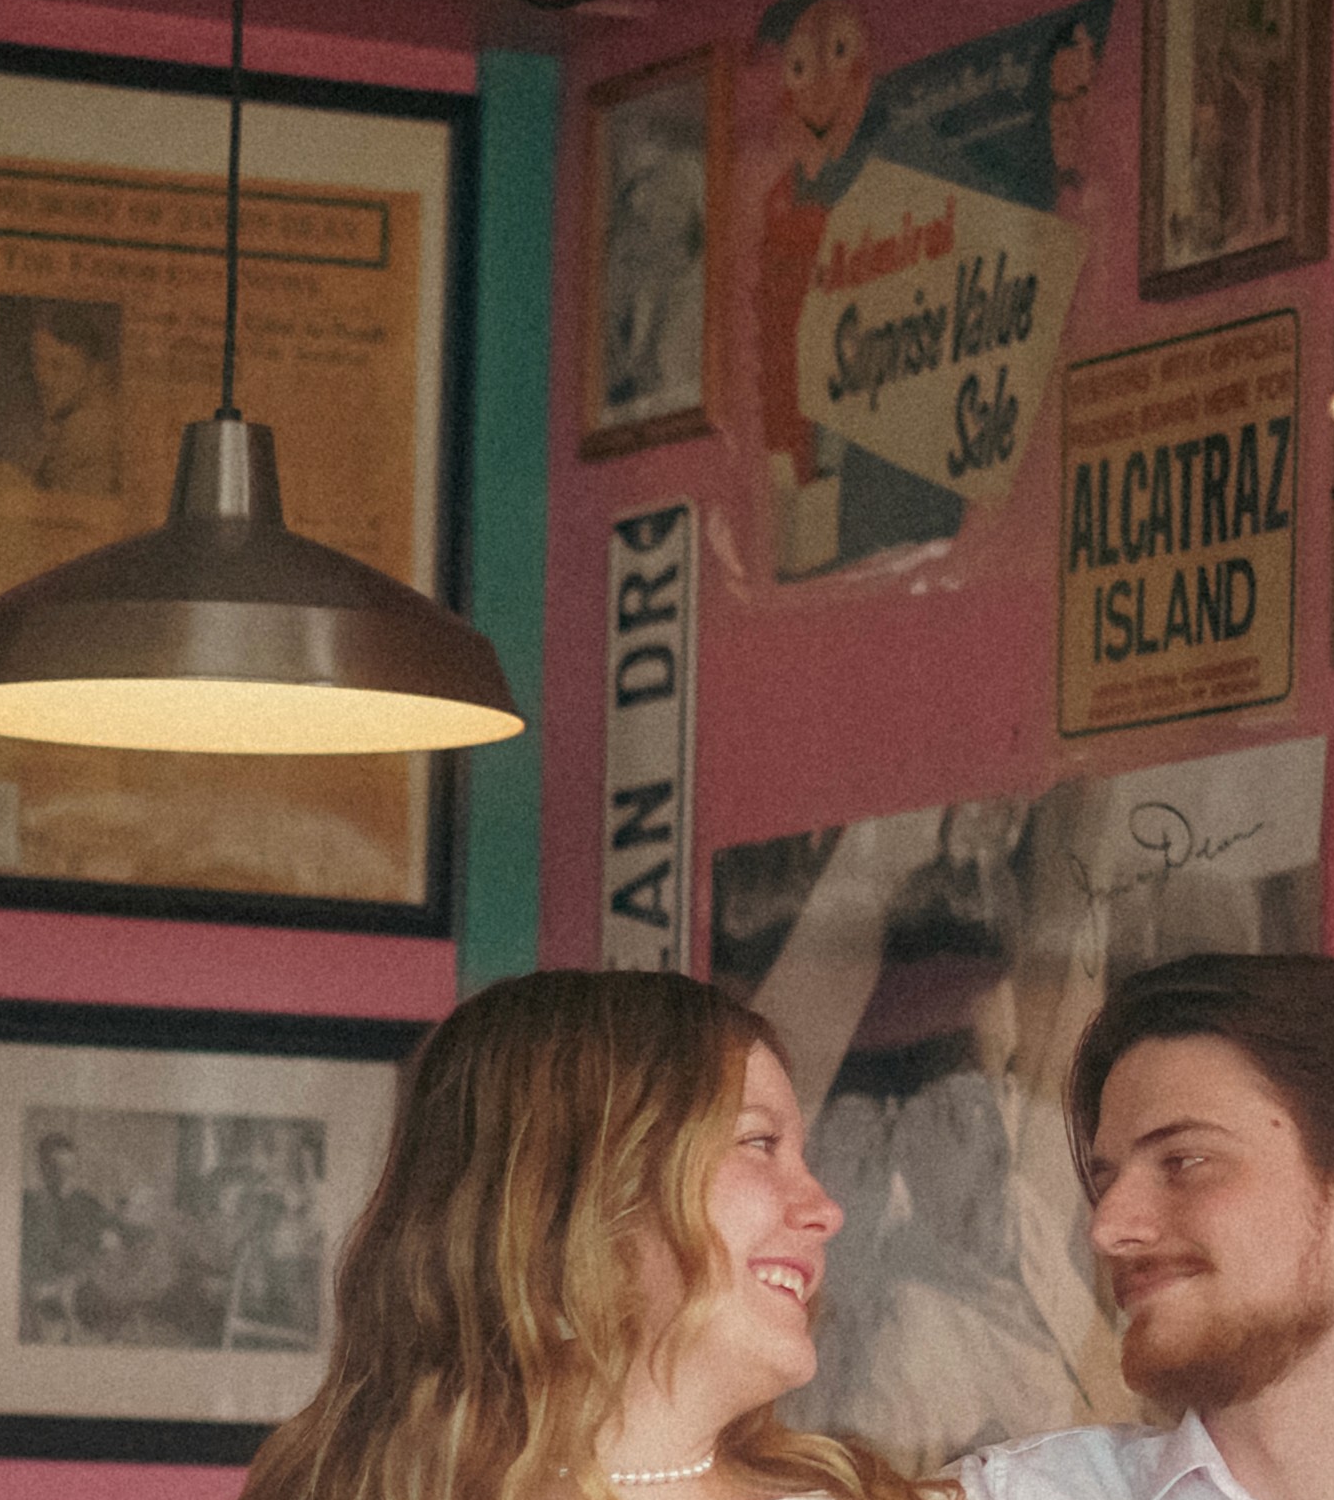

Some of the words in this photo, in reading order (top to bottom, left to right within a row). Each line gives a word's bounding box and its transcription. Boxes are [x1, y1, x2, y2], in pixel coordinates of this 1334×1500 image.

[828, 288, 947, 411] Surprise
[950, 250, 1037, 364] Value
[948, 365, 1018, 478] Sale
[1069, 416, 1291, 573] ALCATRAZ
[616, 563, 679, 708] DR
[1094, 556, 1256, 664] ISLAND
